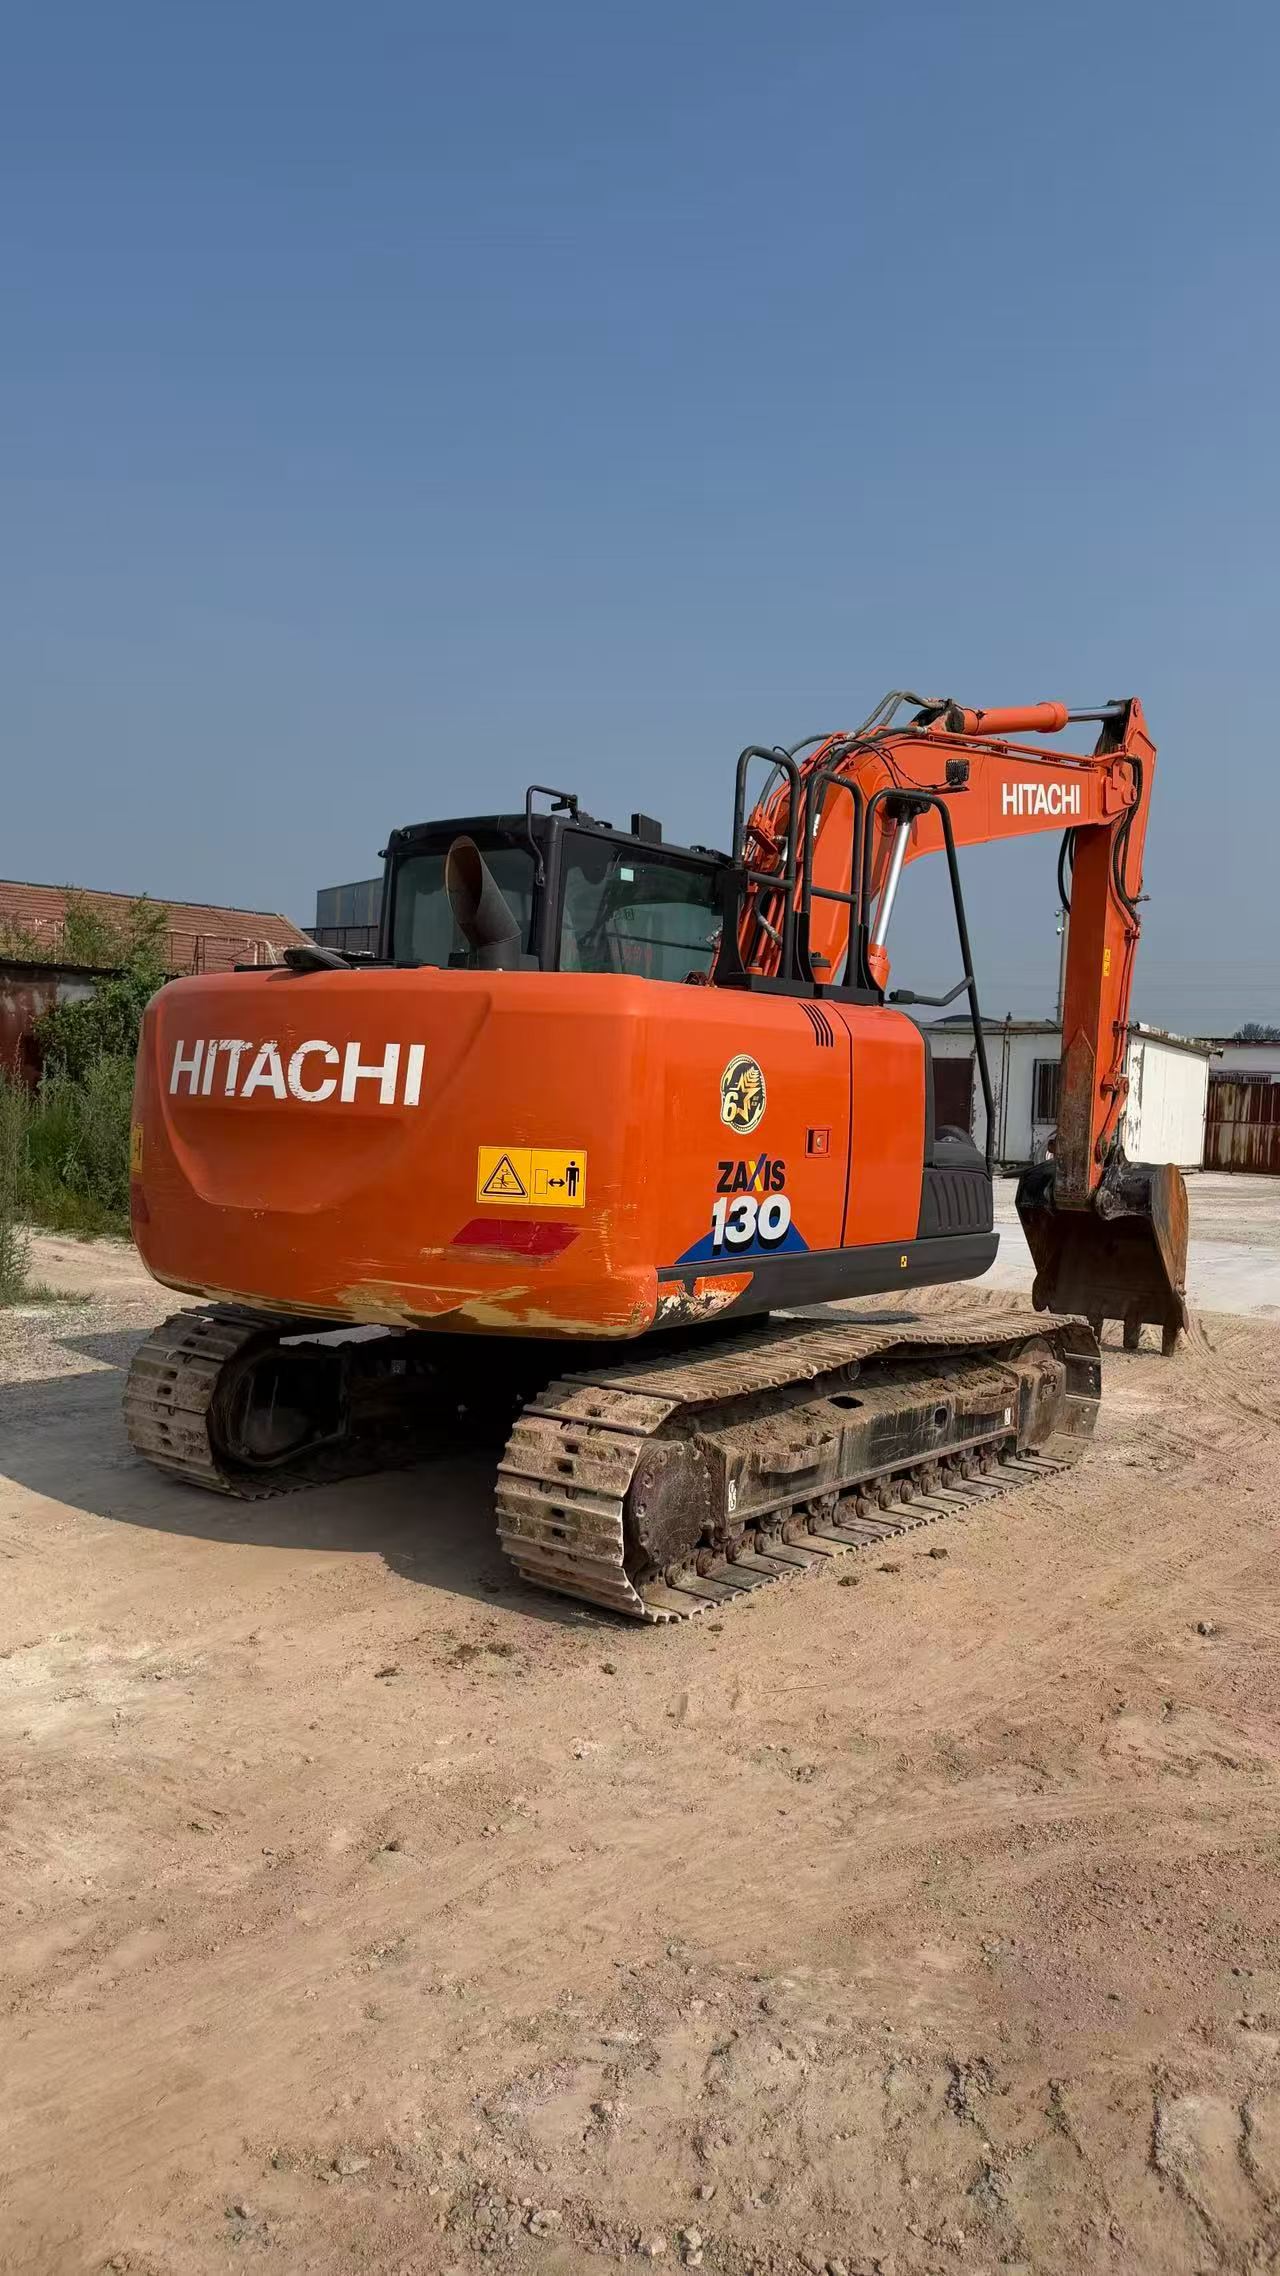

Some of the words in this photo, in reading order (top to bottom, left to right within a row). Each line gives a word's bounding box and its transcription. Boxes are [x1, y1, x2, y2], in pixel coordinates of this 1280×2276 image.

[1002, 783, 1080, 816] HITACHI
[169, 1039, 425, 1106] HITACHI
[722, 1091, 739, 1122] 6
[716, 1153, 786, 1193] ZAXIS
[712, 1193, 792, 1246] 130
